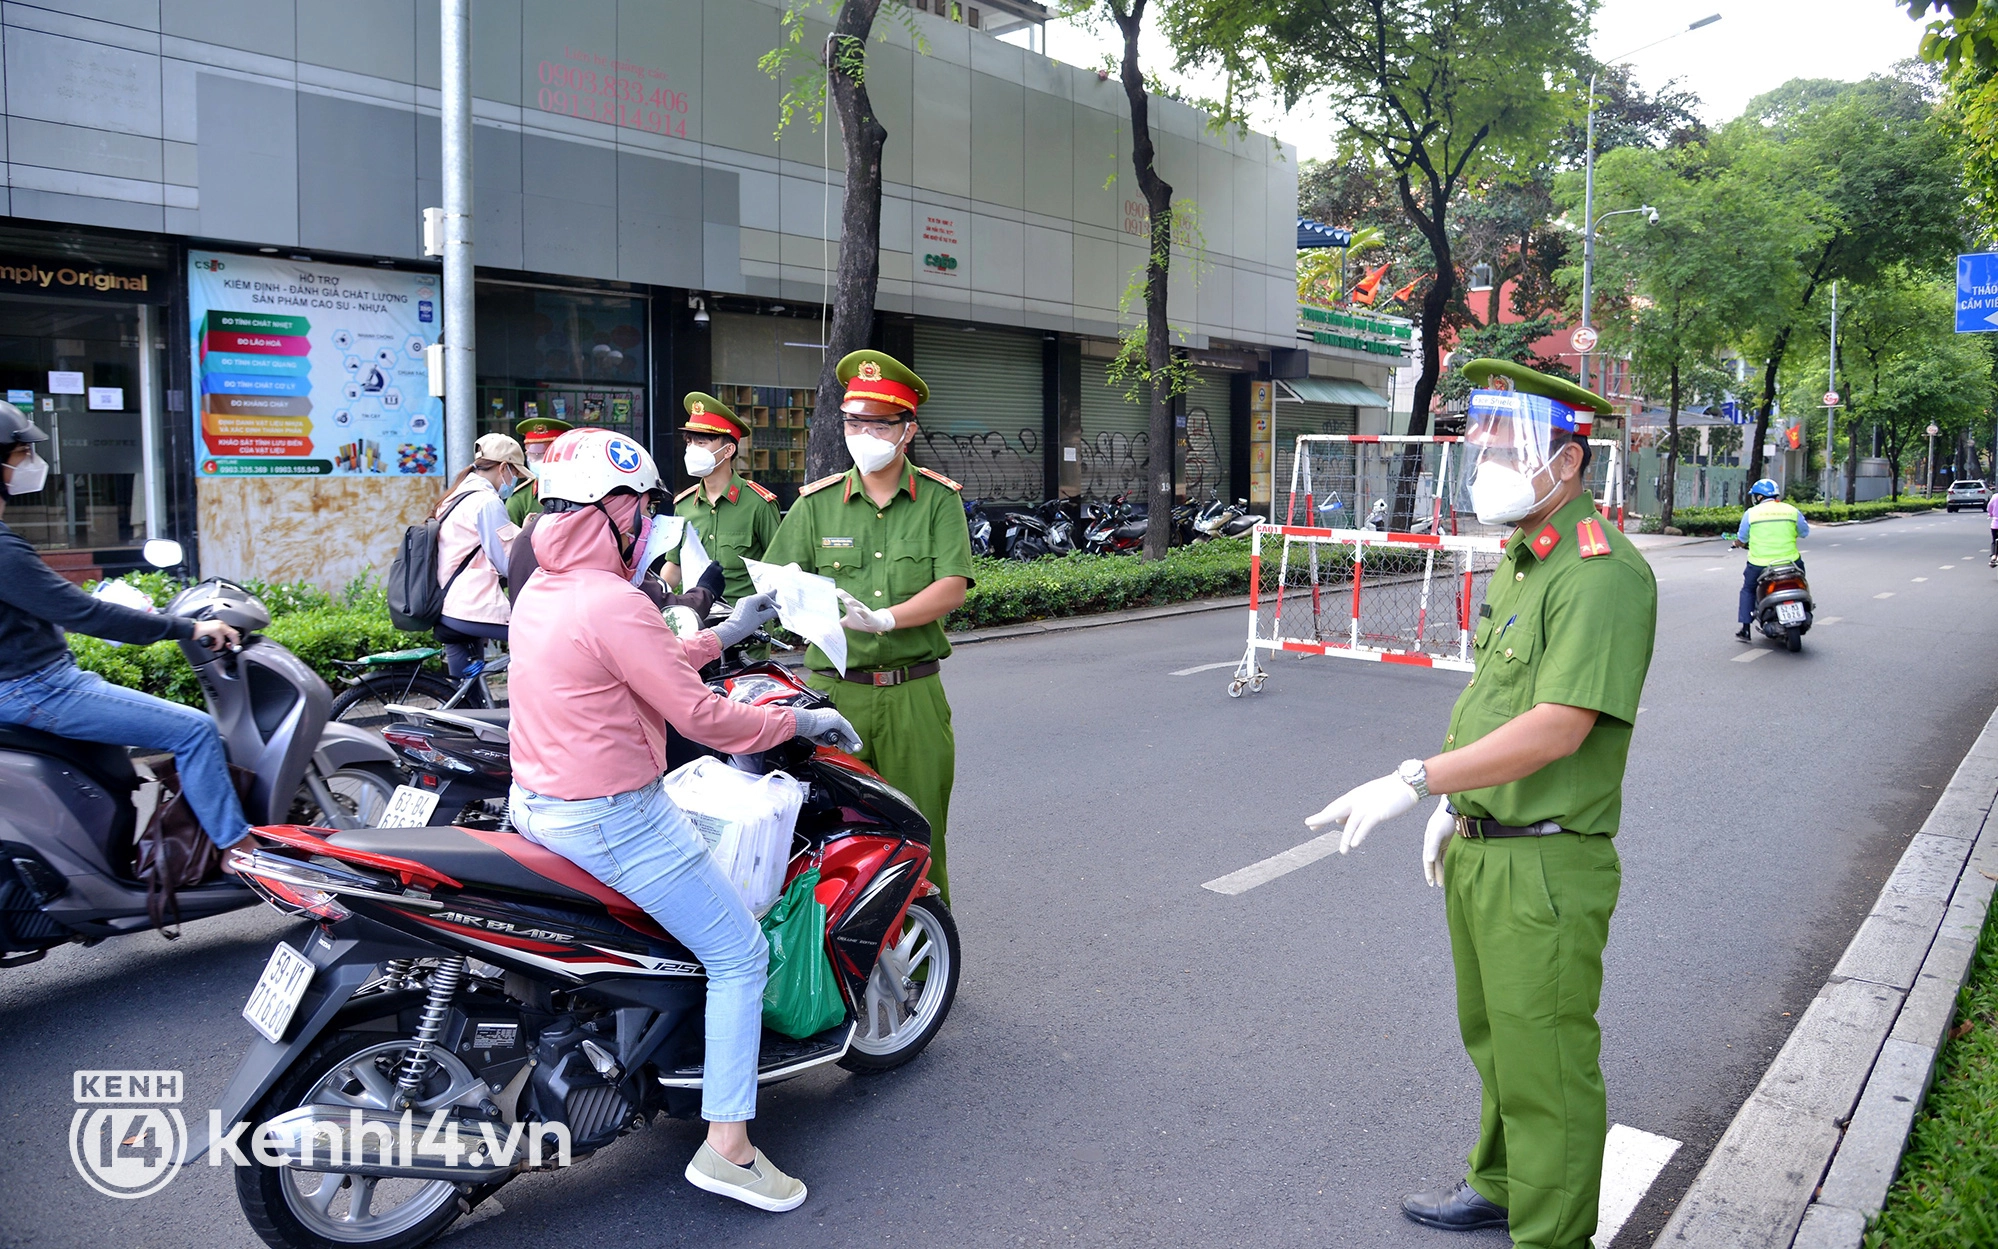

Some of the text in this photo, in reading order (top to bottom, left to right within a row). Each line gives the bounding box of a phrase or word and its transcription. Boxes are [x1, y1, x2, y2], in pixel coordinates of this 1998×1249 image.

[539, 60, 689, 114] 0903.833.406
[539, 88, 688, 139] 0913.814.914
[57, 268, 149, 291] Original
[311, 300, 334, 310] CAO
[336, 301, 350, 311] SU
[1256, 525, 1278, 534] CAQ1
[429, 911, 575, 944] AIR BLADE
[652, 962, 698, 974] 125
